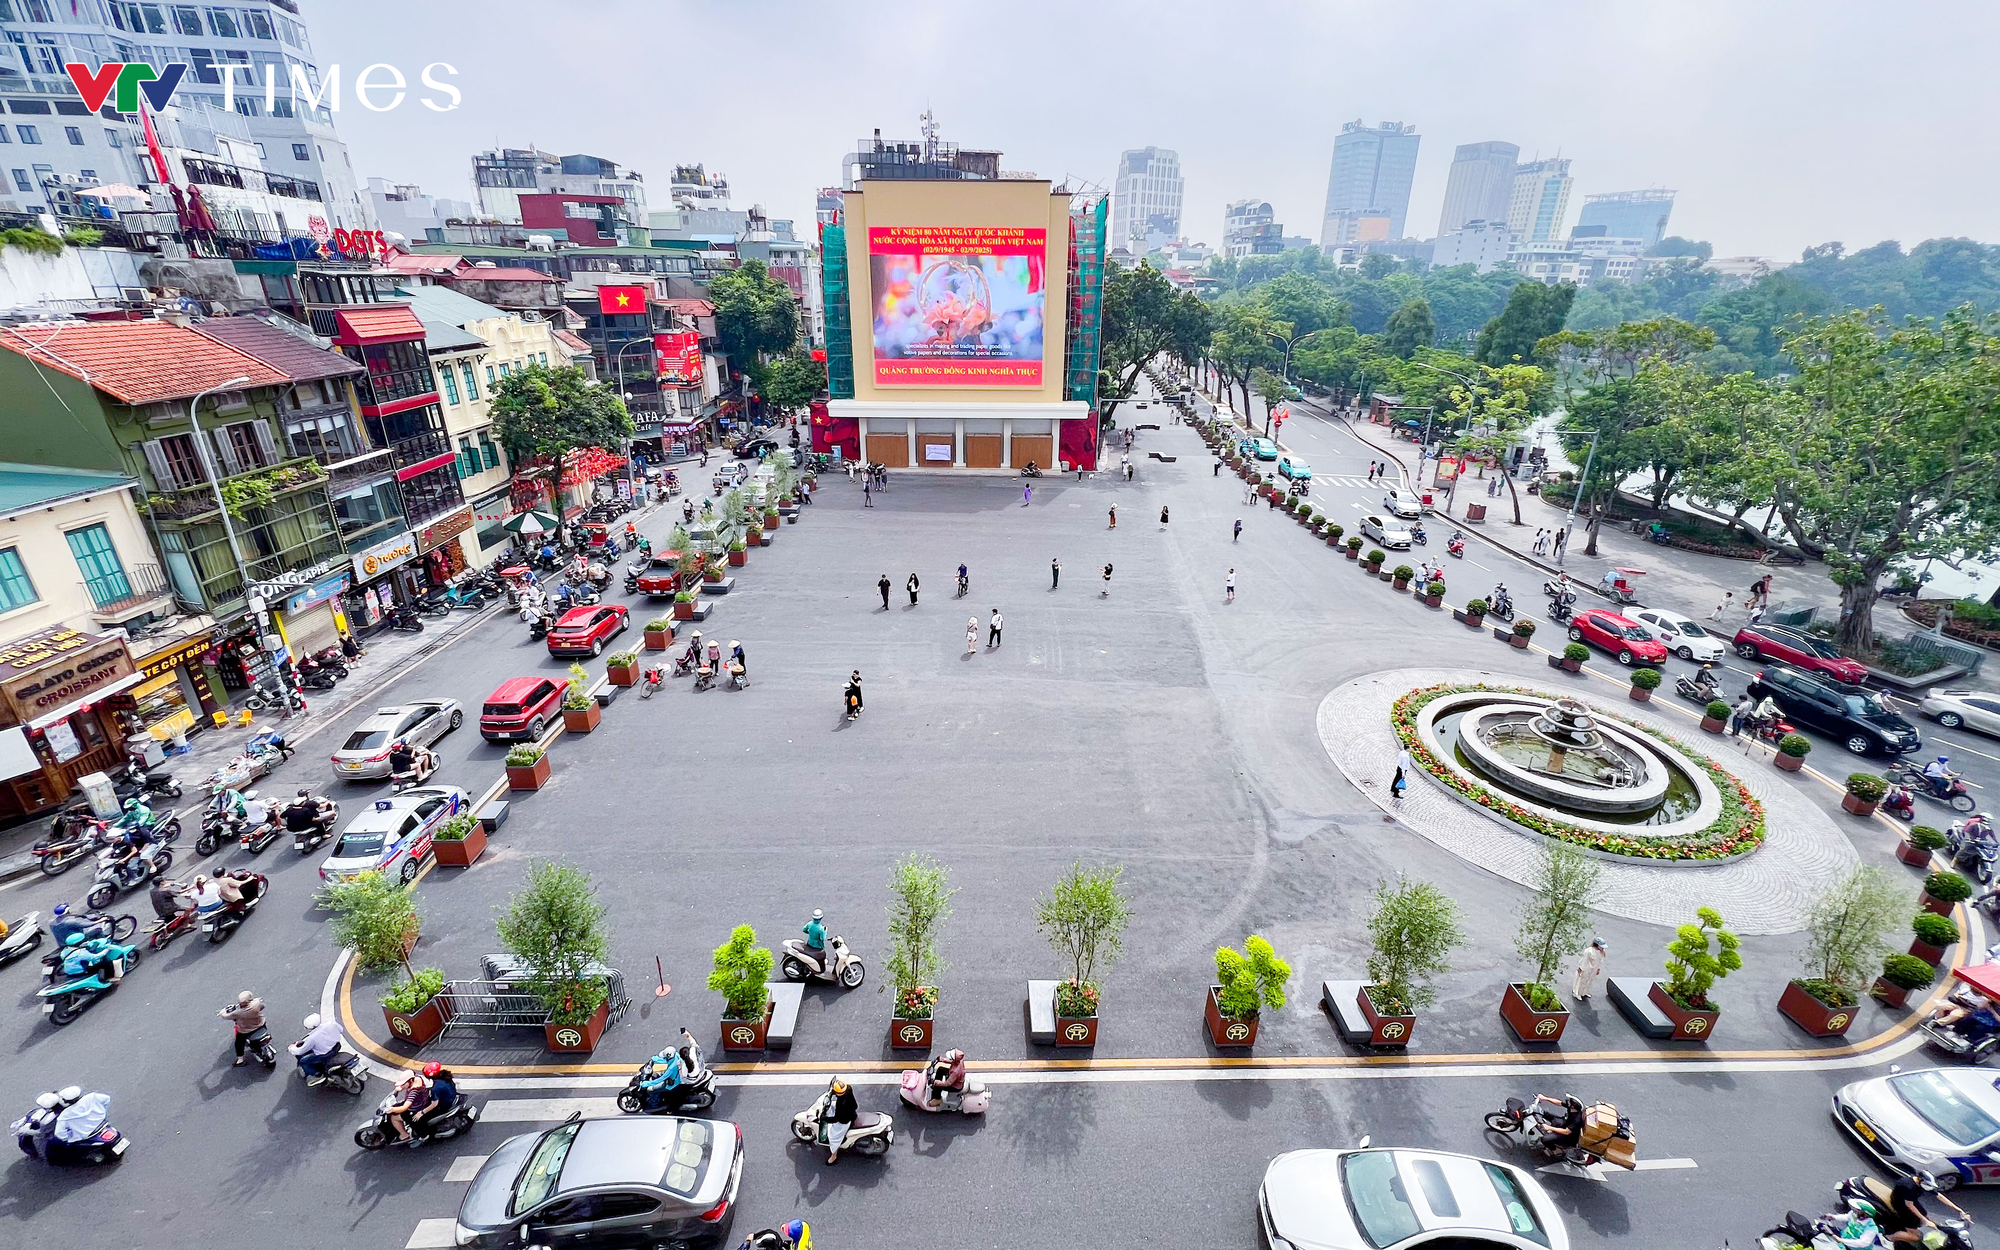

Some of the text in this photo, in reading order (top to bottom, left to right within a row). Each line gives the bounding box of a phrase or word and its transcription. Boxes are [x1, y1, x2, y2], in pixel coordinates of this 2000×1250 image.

[903, 228, 923, 236] NIỆM
[924, 228, 932, 236] 80
[933, 227, 950, 236] NĂM
[951, 227, 973, 236] NGÀY
[974, 227, 996, 238] QUỐC
[997, 227, 1024, 237] KHÁNH
[334, 228, 387, 254] DGTS
[873, 235, 1044, 246] NƯỚC CỘNG HÒA XÃ HỘI CHỦ NGHĨA VIỆT NAM
[923, 246, 955, 254] (02/9/1945
[960, 246, 992, 254] 02/9/2025)
[879, 366, 1038, 377] QUẢNG TRƯỜNG ĐÔNG KINH NGHĨA THỤC
[161, 654, 184, 668] CỘT
[186, 642, 210, 659] ĐÈN
[36, 664, 117, 707] CROISSANT
